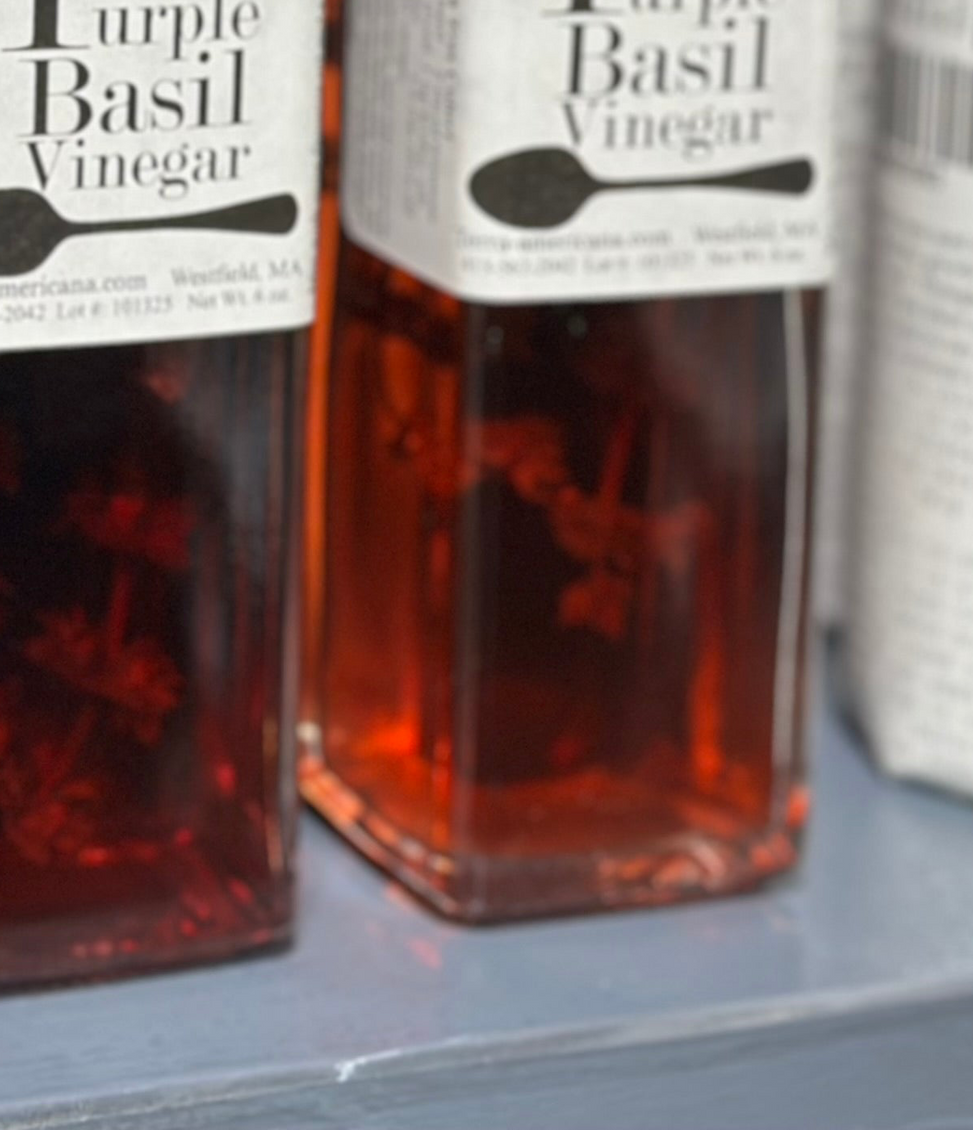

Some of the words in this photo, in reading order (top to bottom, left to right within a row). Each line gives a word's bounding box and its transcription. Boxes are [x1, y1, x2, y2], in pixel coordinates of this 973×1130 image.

[556, 17, 769, 97] Basil
[17, 49, 253, 137] Basil
[558, 99, 773, 161] Vinegar
[20, 137, 253, 200] Vinegar
